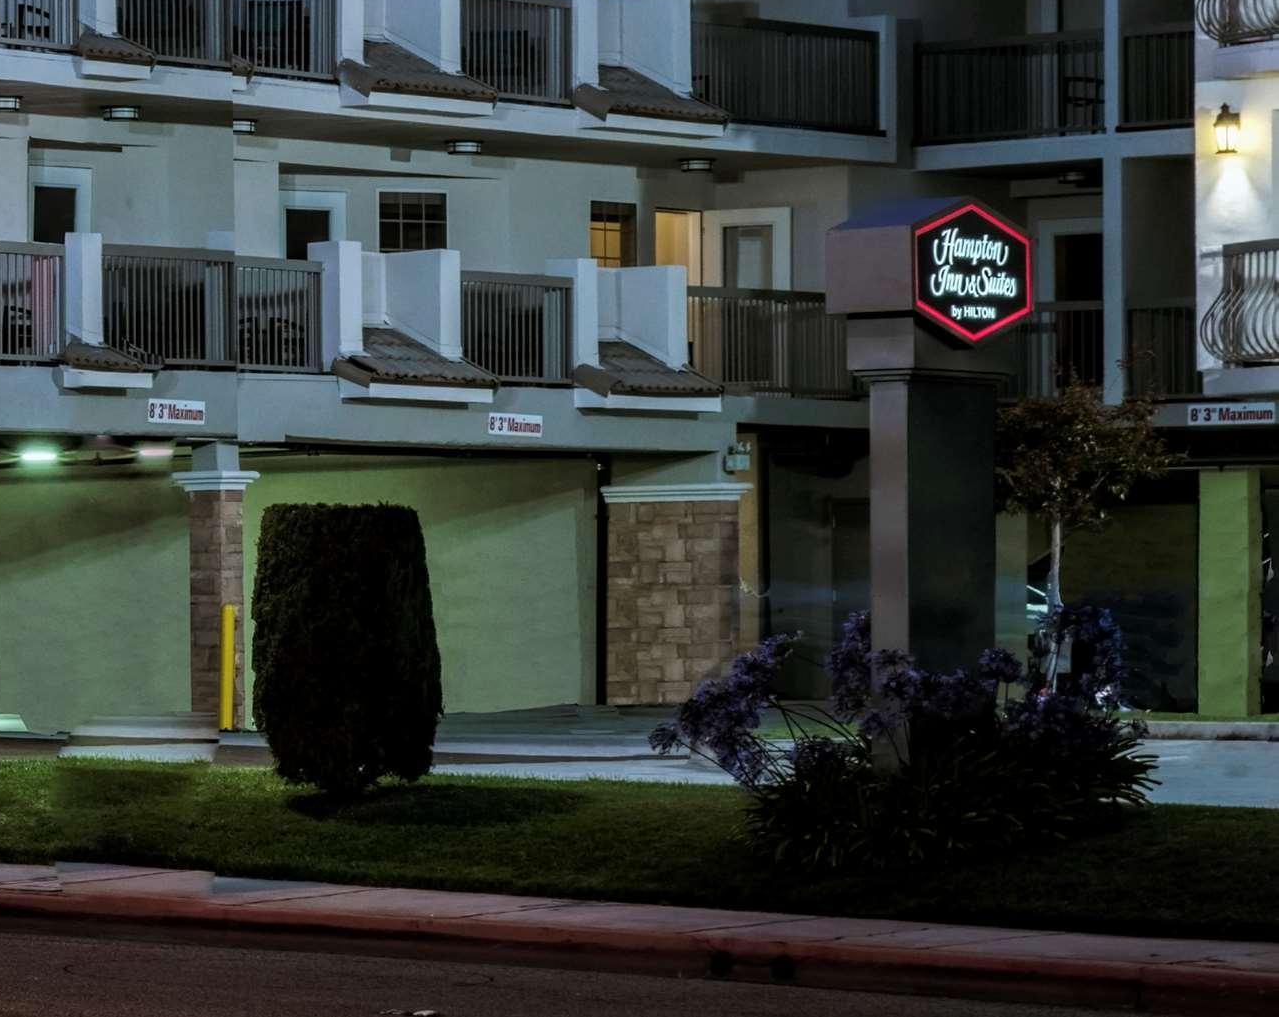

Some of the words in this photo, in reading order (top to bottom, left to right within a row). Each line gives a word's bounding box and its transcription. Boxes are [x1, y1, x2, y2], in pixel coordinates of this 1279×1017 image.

[932, 227, 1010, 266] Hampton
[929, 265, 971, 297] Inn
[968, 276, 980, 298] &
[976, 266, 1018, 298] Suites
[951, 304, 963, 322] by
[963, 305, 997, 320] HILTON
[167, 403, 204, 421] Maximum
[1218, 405, 1274, 422] Maximum
[507, 417, 541, 434] Maximum
